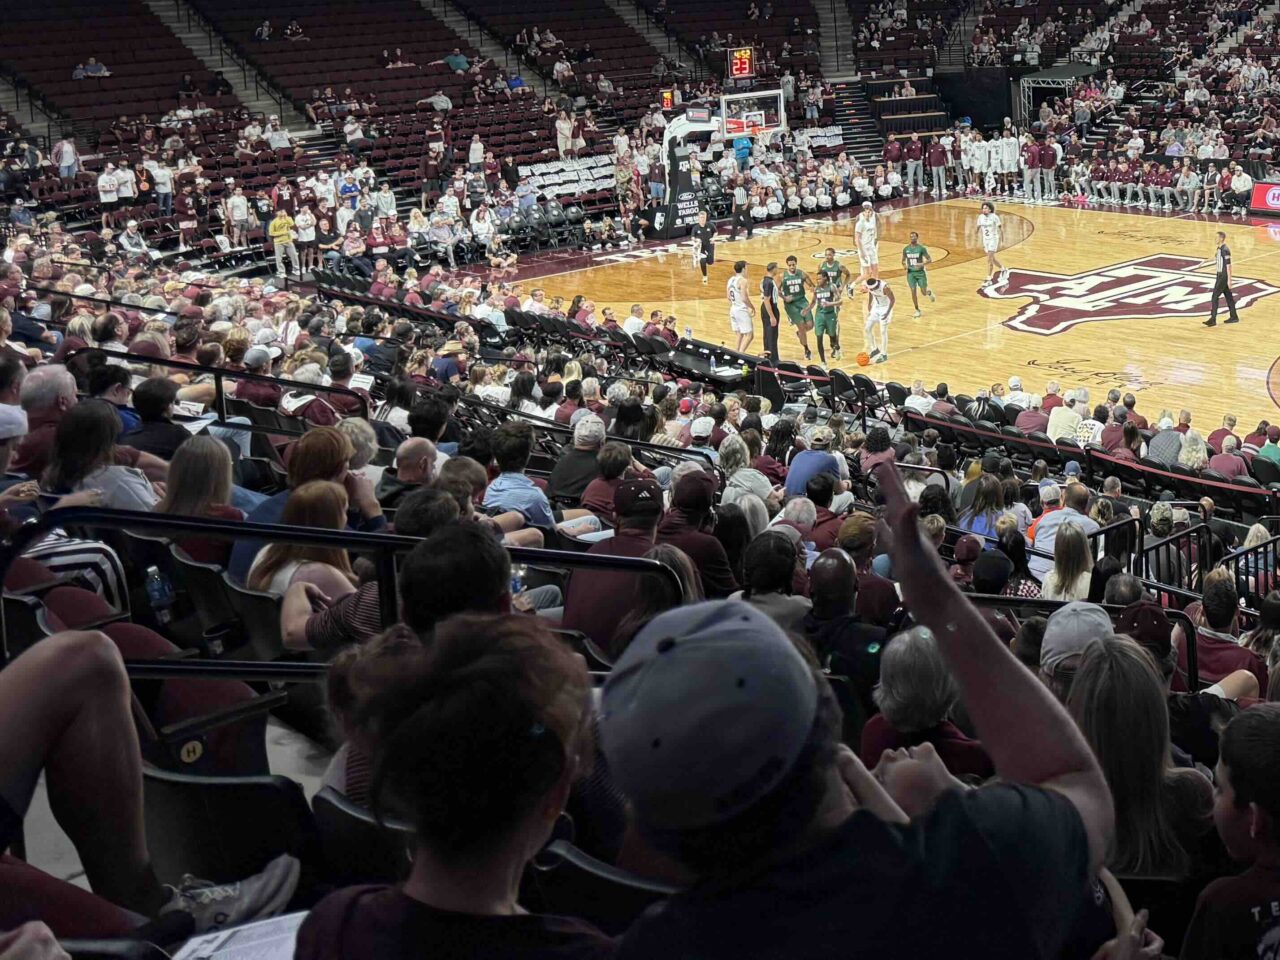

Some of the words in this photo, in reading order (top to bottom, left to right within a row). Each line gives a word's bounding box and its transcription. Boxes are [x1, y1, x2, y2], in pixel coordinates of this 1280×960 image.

[734, 49, 751, 59] 4:52
[732, 58, 749, 75] 23
[677, 201, 699, 210] WELLS
[678, 207, 700, 217] FARGO
[789, 285, 800, 294] 20
[186, 745, 197, 758] H
